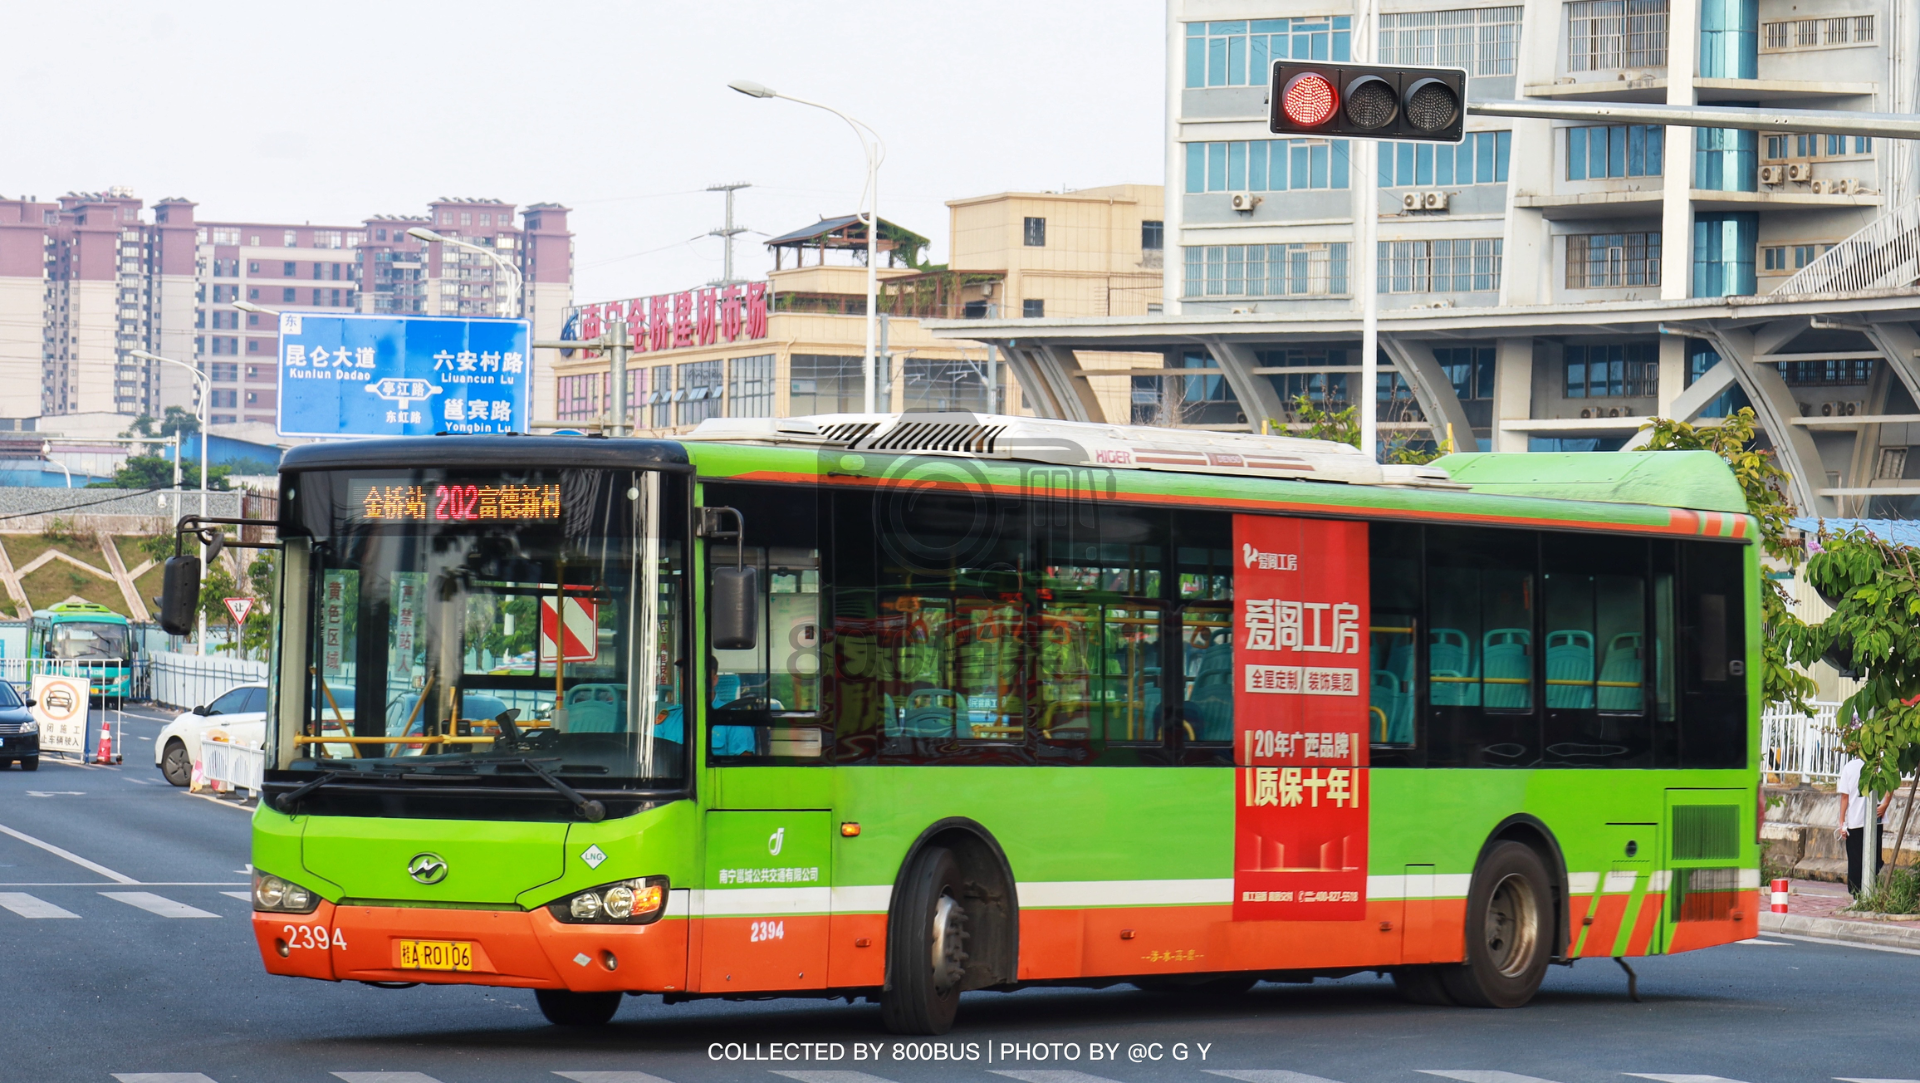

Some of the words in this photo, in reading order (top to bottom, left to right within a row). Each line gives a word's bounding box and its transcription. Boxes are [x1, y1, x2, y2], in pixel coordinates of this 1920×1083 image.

[285, 314, 297, 327] 东
[286, 344, 376, 369] 昆仑大道
[433, 349, 524, 374] 六安村路
[289, 368, 332, 380] Kunlun
[336, 369, 371, 381] Dadao
[441, 373, 495, 385] Liuancun
[500, 374, 515, 385] Lu
[382, 381, 425, 398] 亭江路
[386, 410, 422, 424] 东虹路
[444, 398, 512, 422] 邕宾路
[445, 421, 492, 434] Yongbin
[497, 422, 511, 433] Lu
[1095, 449, 1132, 465] HIGER
[363, 485, 427, 520] 金桥站
[435, 485, 479, 520] 202
[478, 484, 561, 519] 富德新村
[1258, 552, 1298, 571] 爱阁工房
[234, 602, 245, 614] 让
[325, 581, 342, 670] 黄色区域
[1245, 598, 1360, 654] 爱阁工房
[1252, 669, 1298, 690] 全屋定制
[1308, 671, 1353, 692] 装饰集团
[40, 734, 80, 748] 止车辆驶入
[1254, 729, 1350, 759] 20年广西品牌
[1254, 767, 1350, 808] 质保十年
[585, 852, 603, 861] LNG
[719, 867, 819, 884] 南宁邕城公共交通有限公司
[283, 924, 348, 951] 2394
[750, 920, 785, 943] 2394
